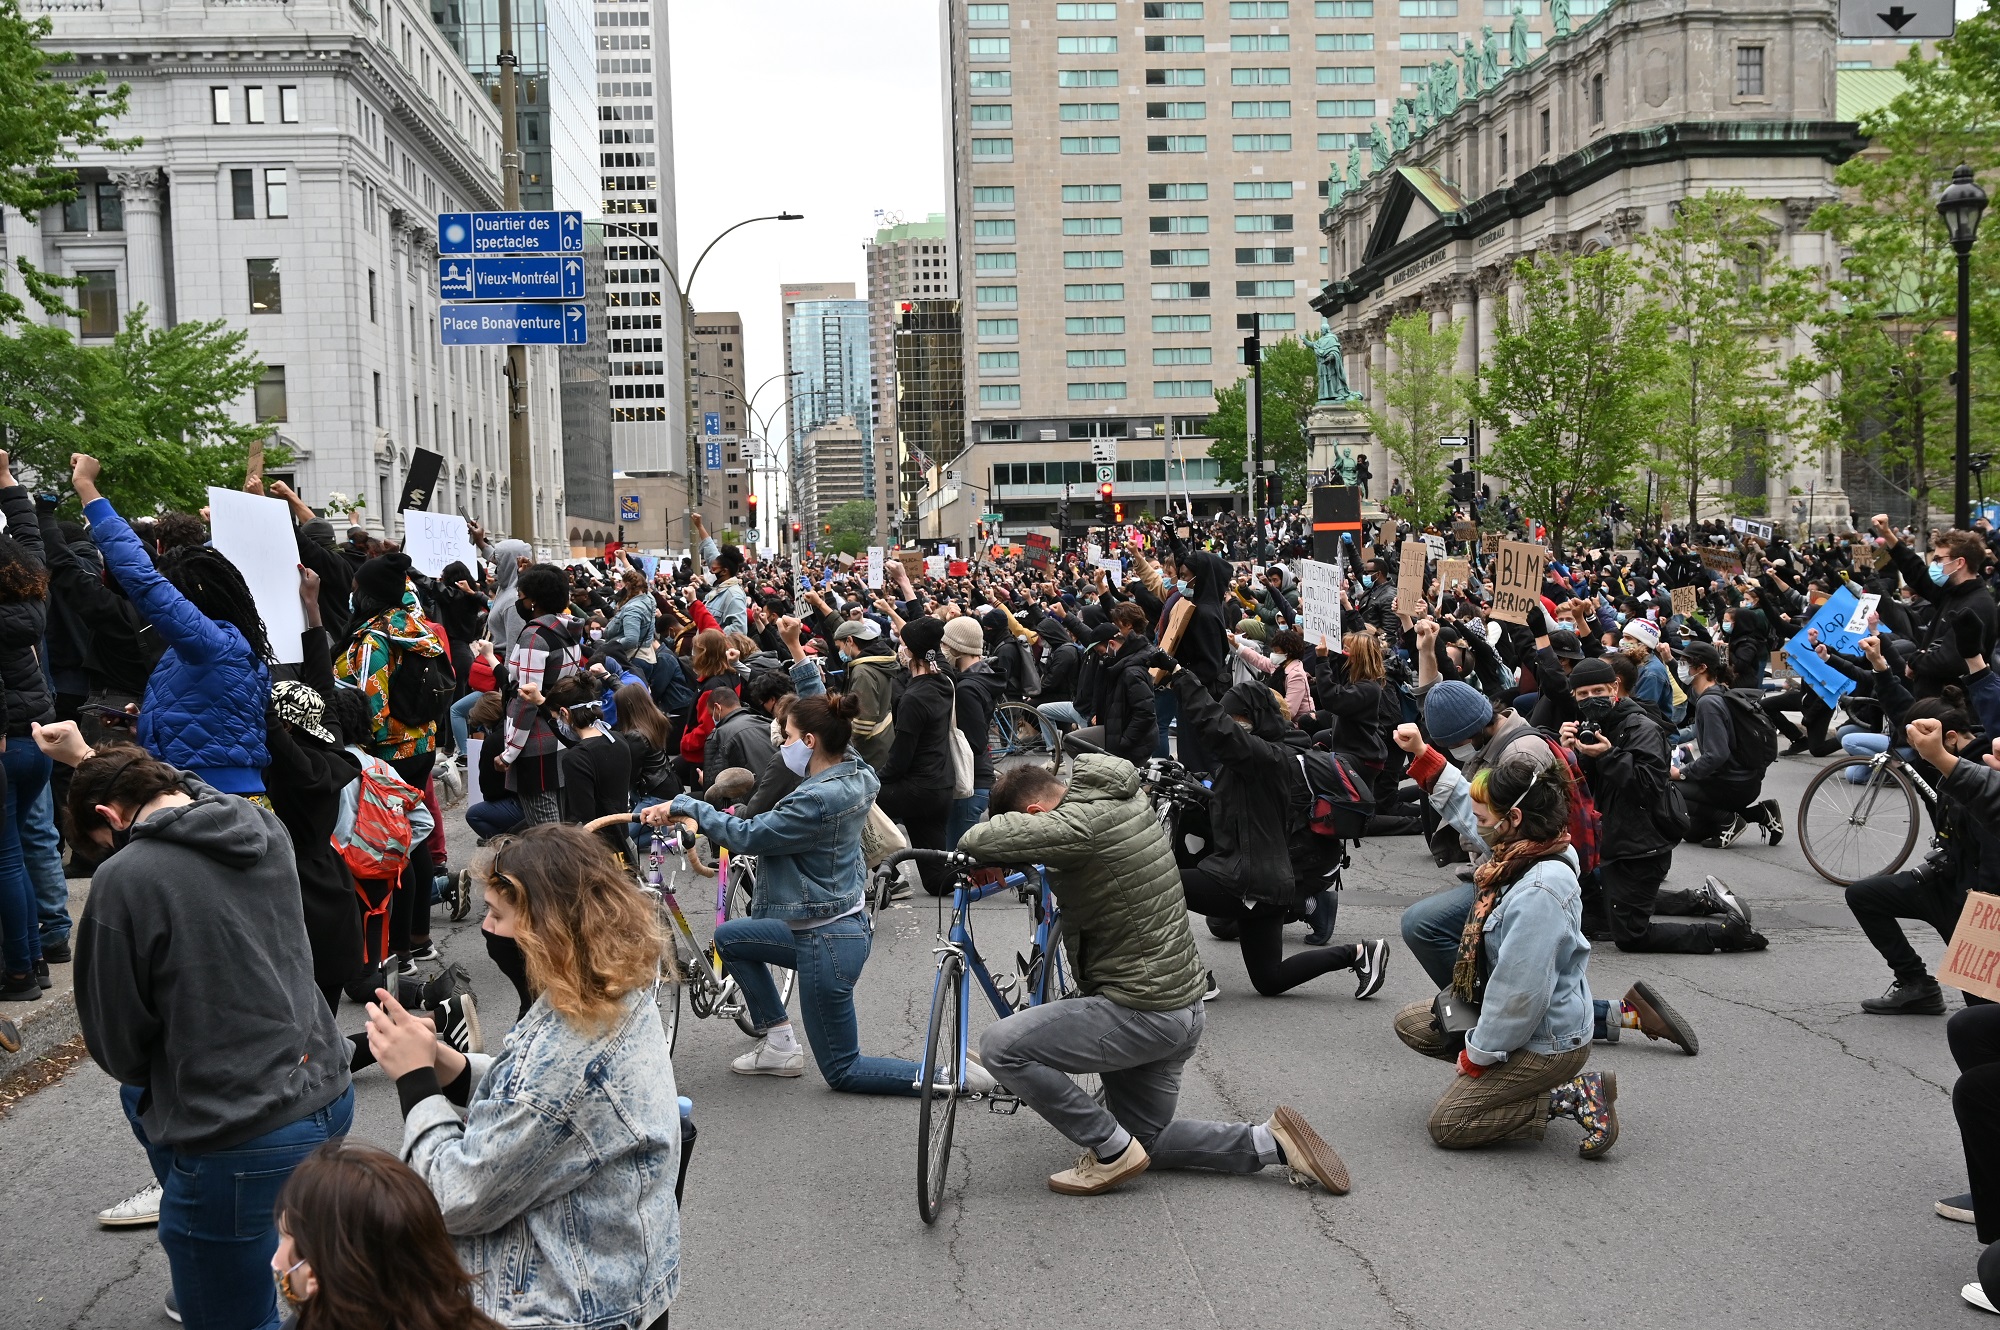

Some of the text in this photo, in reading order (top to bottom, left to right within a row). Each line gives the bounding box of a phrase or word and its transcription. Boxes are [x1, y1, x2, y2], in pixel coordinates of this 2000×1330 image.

[476, 217, 550, 230] Quartier des
[476, 235, 540, 251] spectacles
[563, 236, 582, 250] 0,5
[476, 271, 559, 286] Vieux-Montréal
[571, 282, 576, 295] 1
[443, 316, 561, 330] Place Bonaventure
[573, 328, 578, 342] 1
[424, 516, 461, 540] BLACK
[432, 540, 460, 557] LIVES
[1502, 548, 1540, 592] BLM
[1673, 587, 1693, 598] BLACK
[1496, 591, 1535, 614] PERIOD
[1306, 614, 1340, 642] EVERYWHERE
[1949, 940, 2000, 984] KILLER
